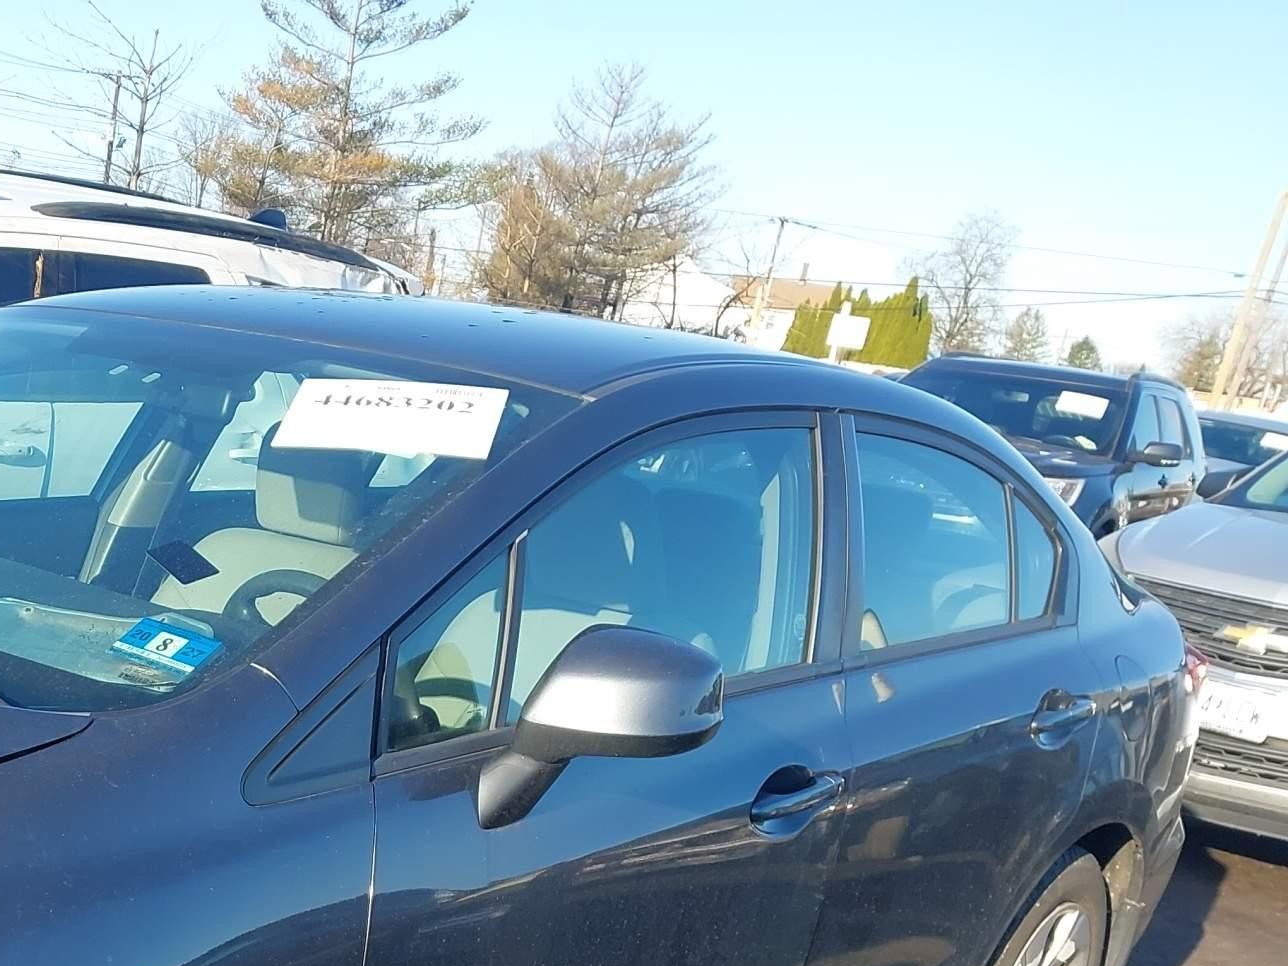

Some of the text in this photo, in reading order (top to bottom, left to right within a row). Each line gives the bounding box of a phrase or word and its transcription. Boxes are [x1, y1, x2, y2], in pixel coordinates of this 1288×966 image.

[313, 393, 475, 414] 44683202
[131, 628, 153, 642] 20
[155, 637, 175, 652] 8
